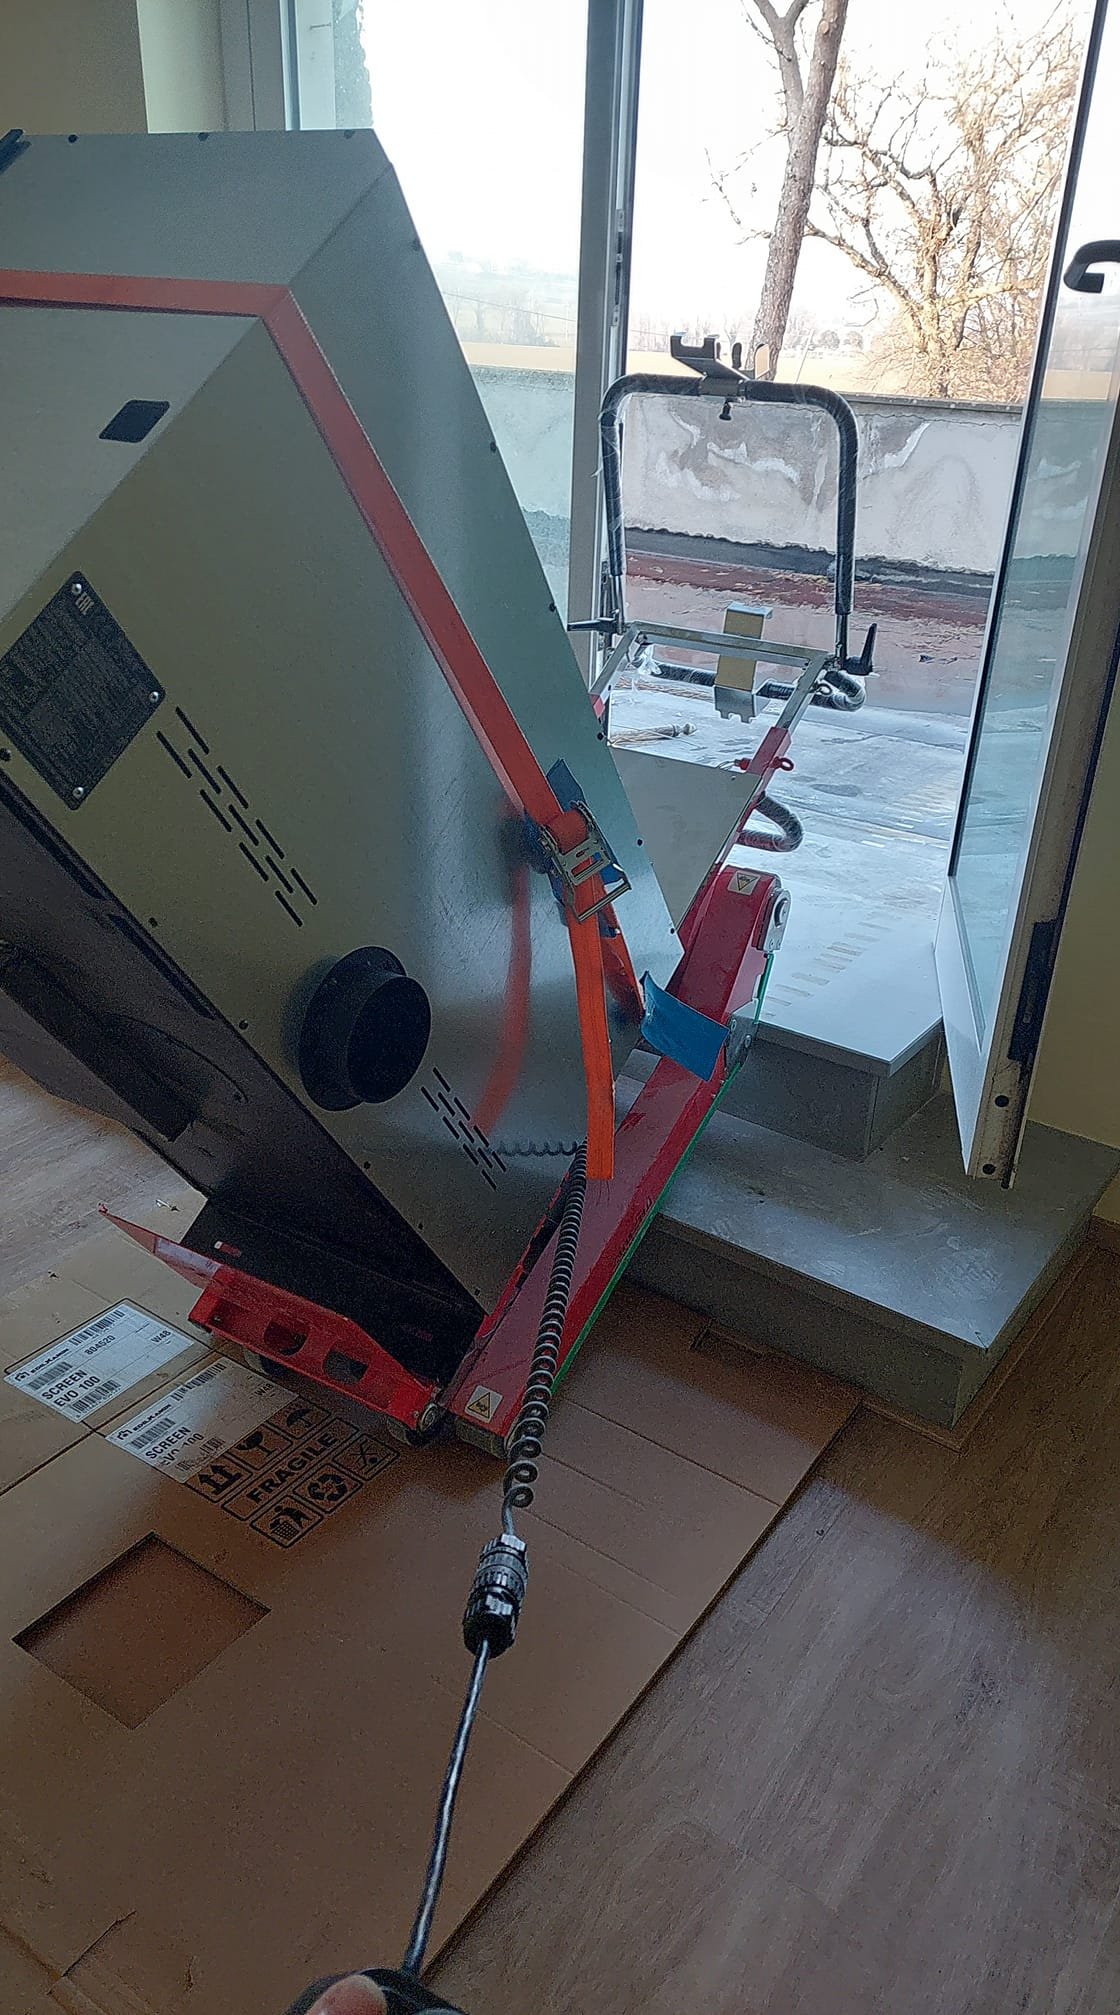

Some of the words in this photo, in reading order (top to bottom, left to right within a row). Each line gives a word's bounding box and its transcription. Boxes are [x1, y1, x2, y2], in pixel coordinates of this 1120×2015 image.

[41, 1369, 88, 1399] SCREEN
[53, 1390, 79, 1407] EVO
[78, 1376, 100, 1393] 100
[145, 1426, 191, 1459] SCREEN
[246, 1433, 338, 1503] FRAGILE
